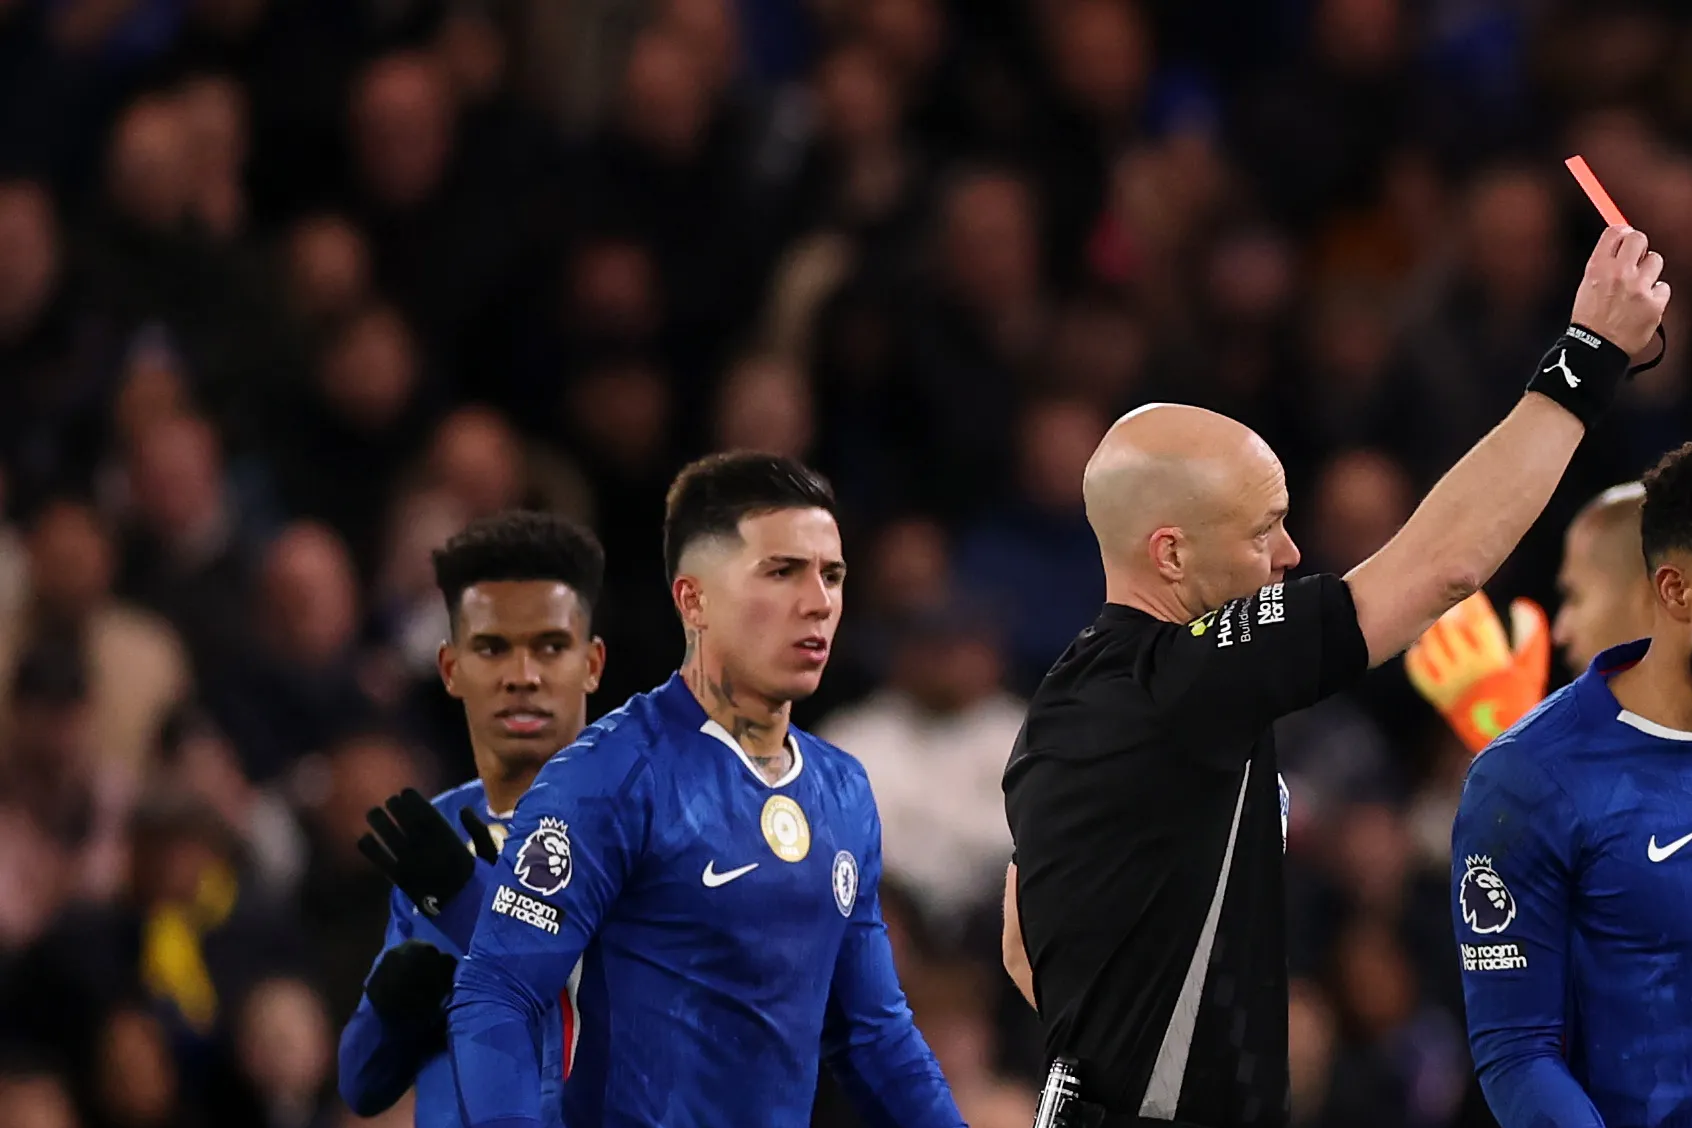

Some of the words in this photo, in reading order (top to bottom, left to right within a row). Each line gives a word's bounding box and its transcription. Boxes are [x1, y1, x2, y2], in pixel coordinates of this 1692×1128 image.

[1257, 602, 1272, 625] No
[495, 884, 517, 902] No
[515, 894, 558, 920] room
[510, 905, 560, 935] racism
[1460, 943, 1477, 958] No
[1477, 943, 1519, 959] room
[1478, 955, 1528, 971] racism
